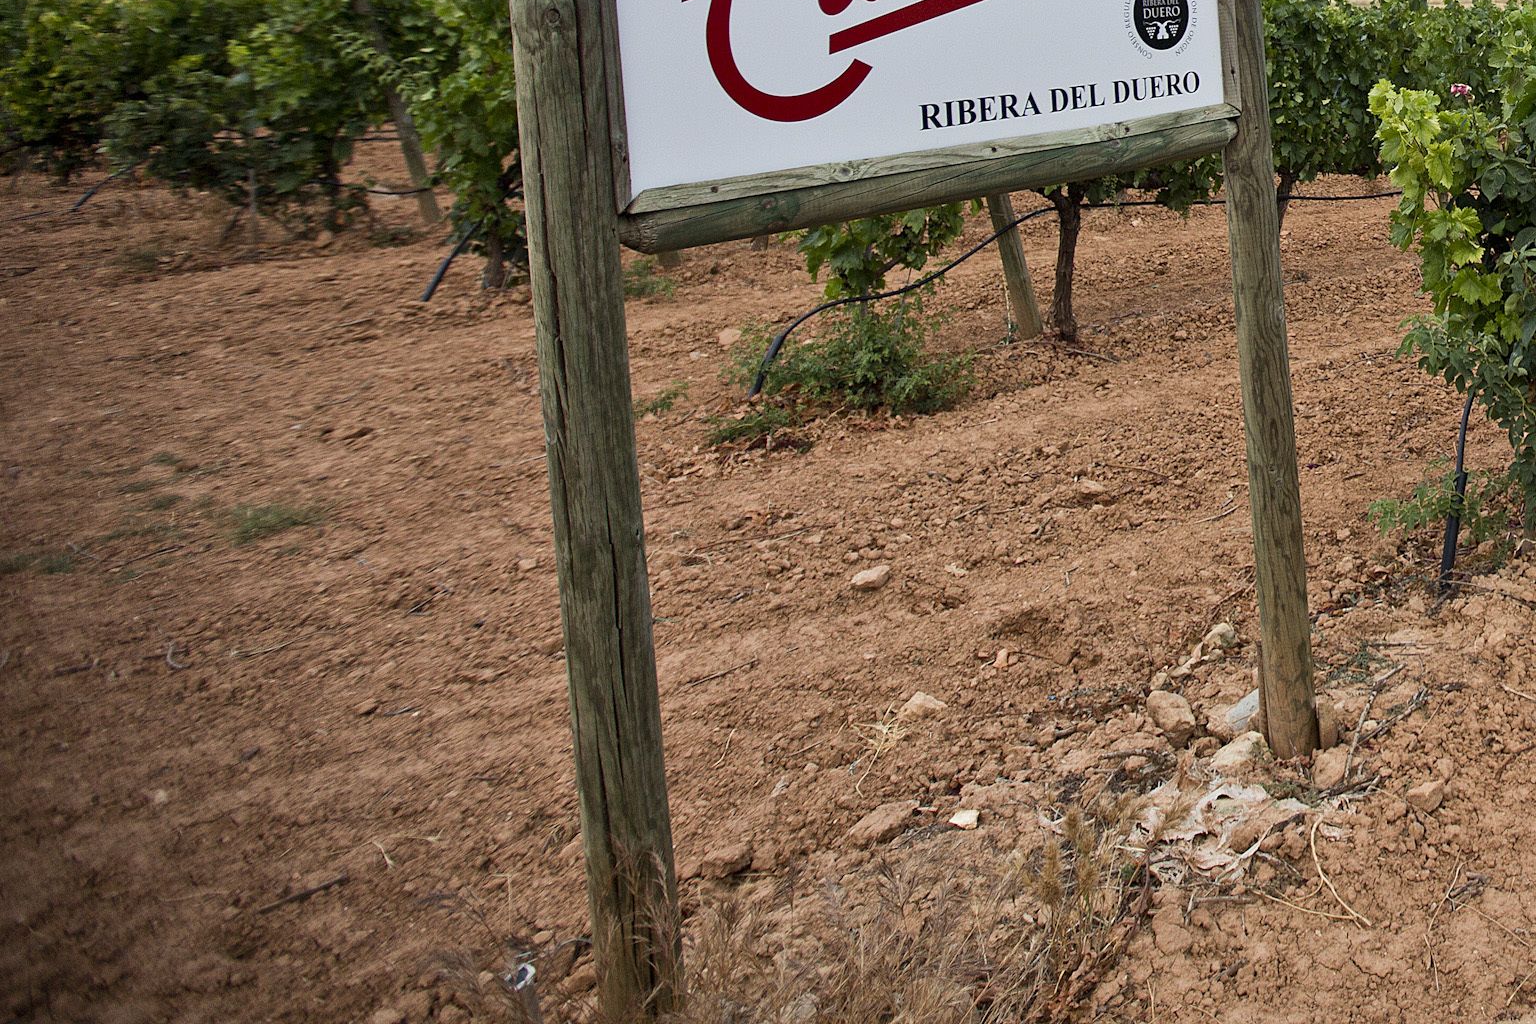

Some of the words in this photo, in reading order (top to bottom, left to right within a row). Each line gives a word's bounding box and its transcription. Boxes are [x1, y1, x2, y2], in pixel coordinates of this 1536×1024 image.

[1143, 5, 1181, 19] DUERO
[1128, 31, 1153, 59] CONSEJO
[919, 91, 1042, 131] RIBERA
[1049, 83, 1106, 113] DEL
[1112, 71, 1200, 104] DUERO
